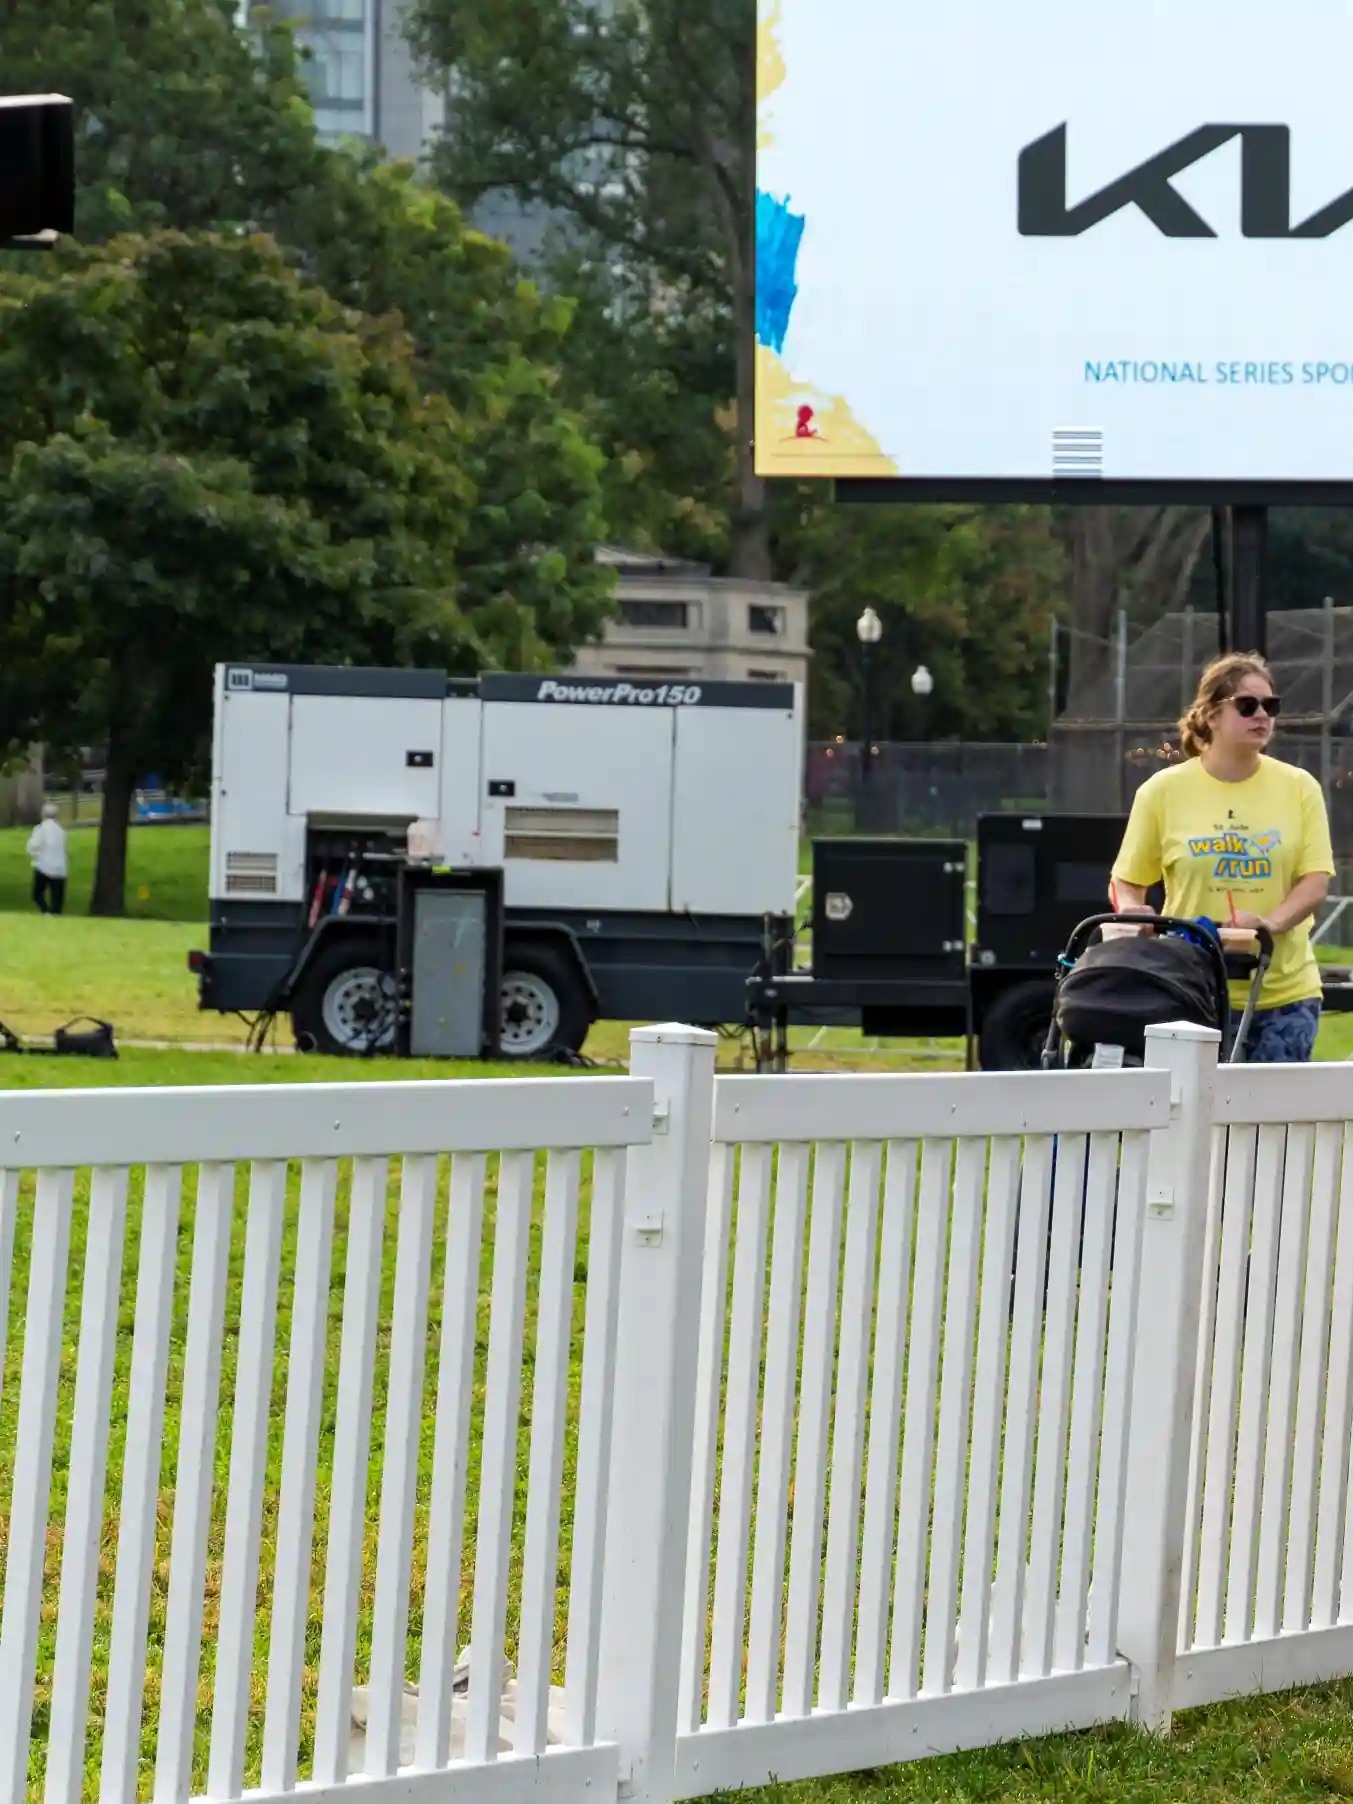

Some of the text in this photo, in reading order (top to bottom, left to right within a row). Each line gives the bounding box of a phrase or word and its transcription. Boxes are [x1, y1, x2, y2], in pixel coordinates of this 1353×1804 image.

[1083, 360, 1208, 383] NATIONAL
[1215, 361, 1294, 384] SERIES
[536, 679, 702, 705] PowerPro150
[1190, 834, 1246, 855] walk
